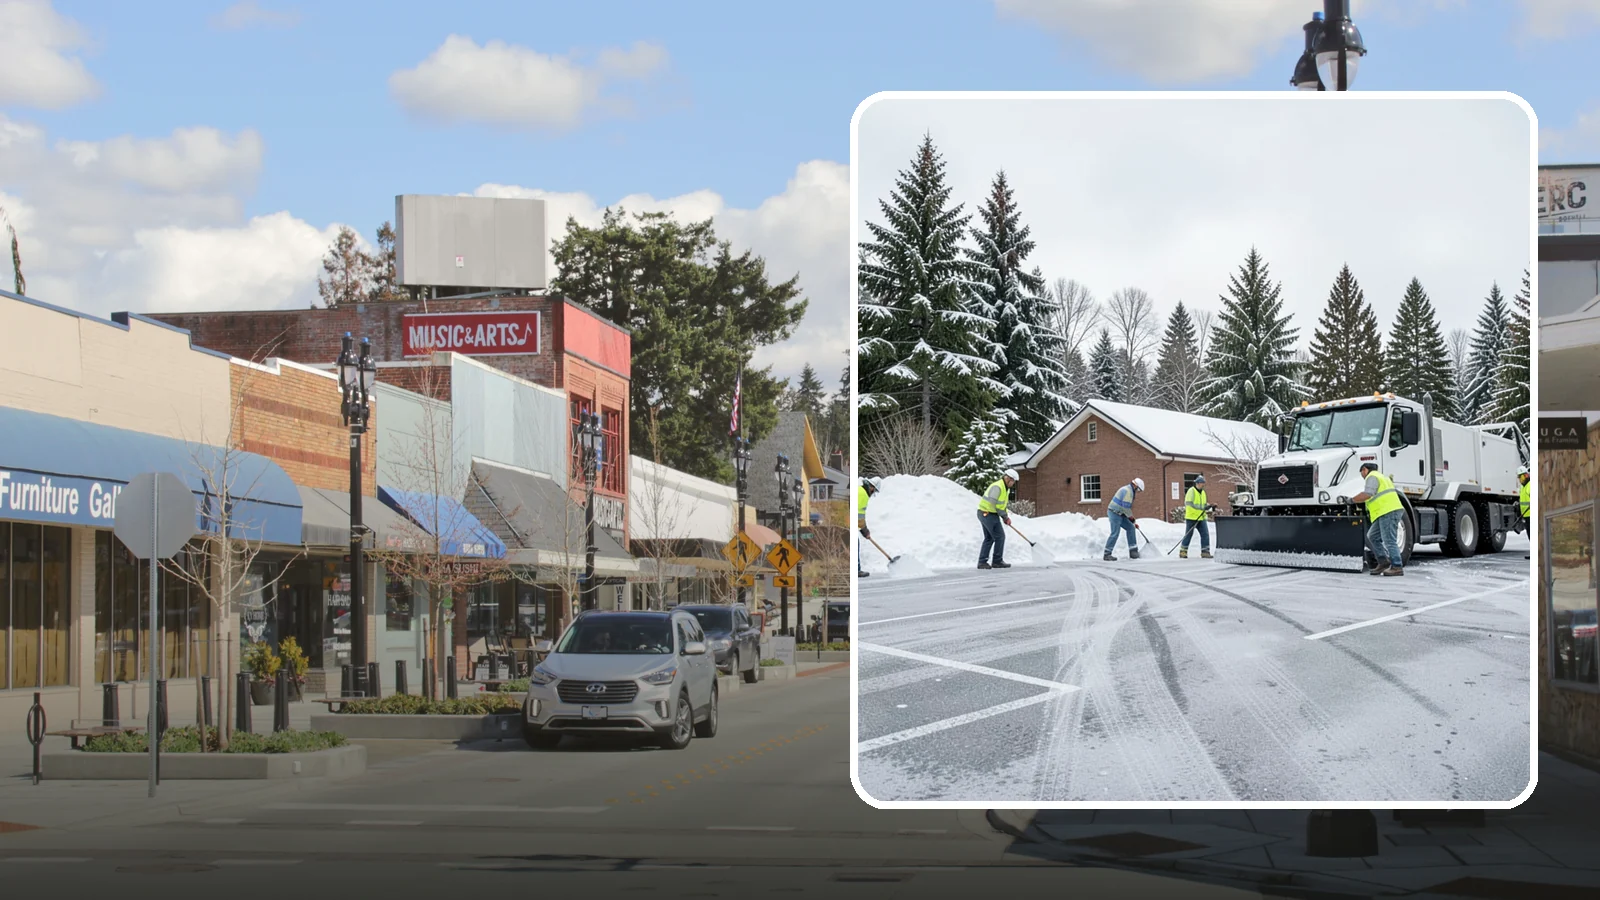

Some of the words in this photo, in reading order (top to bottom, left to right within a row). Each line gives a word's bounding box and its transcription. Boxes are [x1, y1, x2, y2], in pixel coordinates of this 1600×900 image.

[409, 323, 520, 349] MUSIC&ARTS
[1540, 427, 1578, 437] UGA
[0, 471, 80, 515] Furniture
